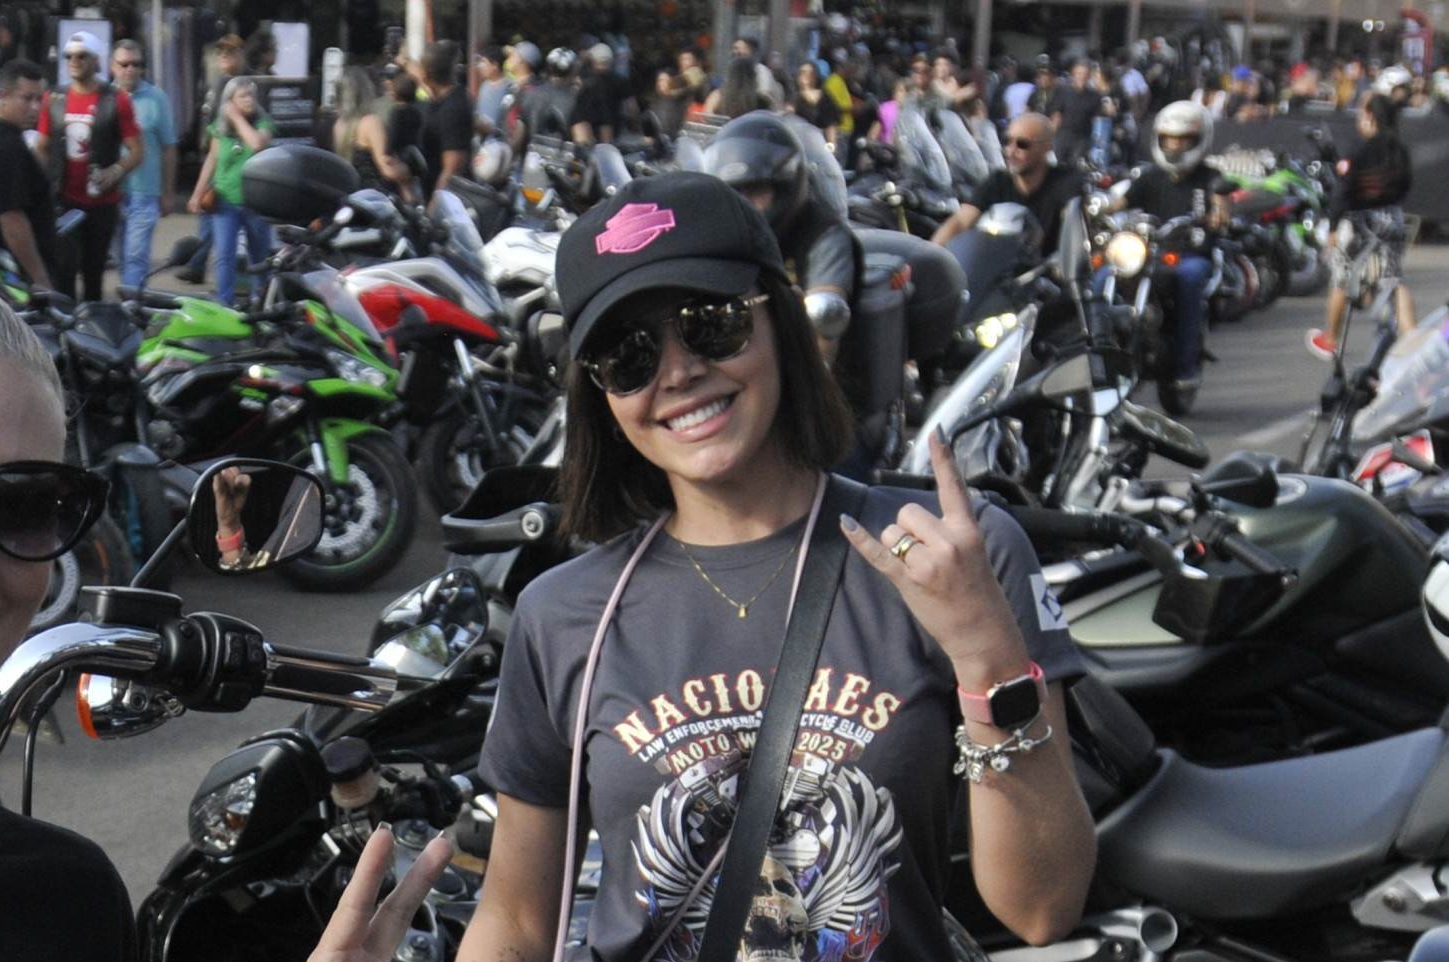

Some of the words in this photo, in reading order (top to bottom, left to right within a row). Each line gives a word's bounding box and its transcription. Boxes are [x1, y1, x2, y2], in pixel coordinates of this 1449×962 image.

[613, 667, 901, 754] NACIOAES
[638, 738, 666, 763] LAW
[670, 733, 730, 773] MOTO
[799, 731, 847, 760] 2025
